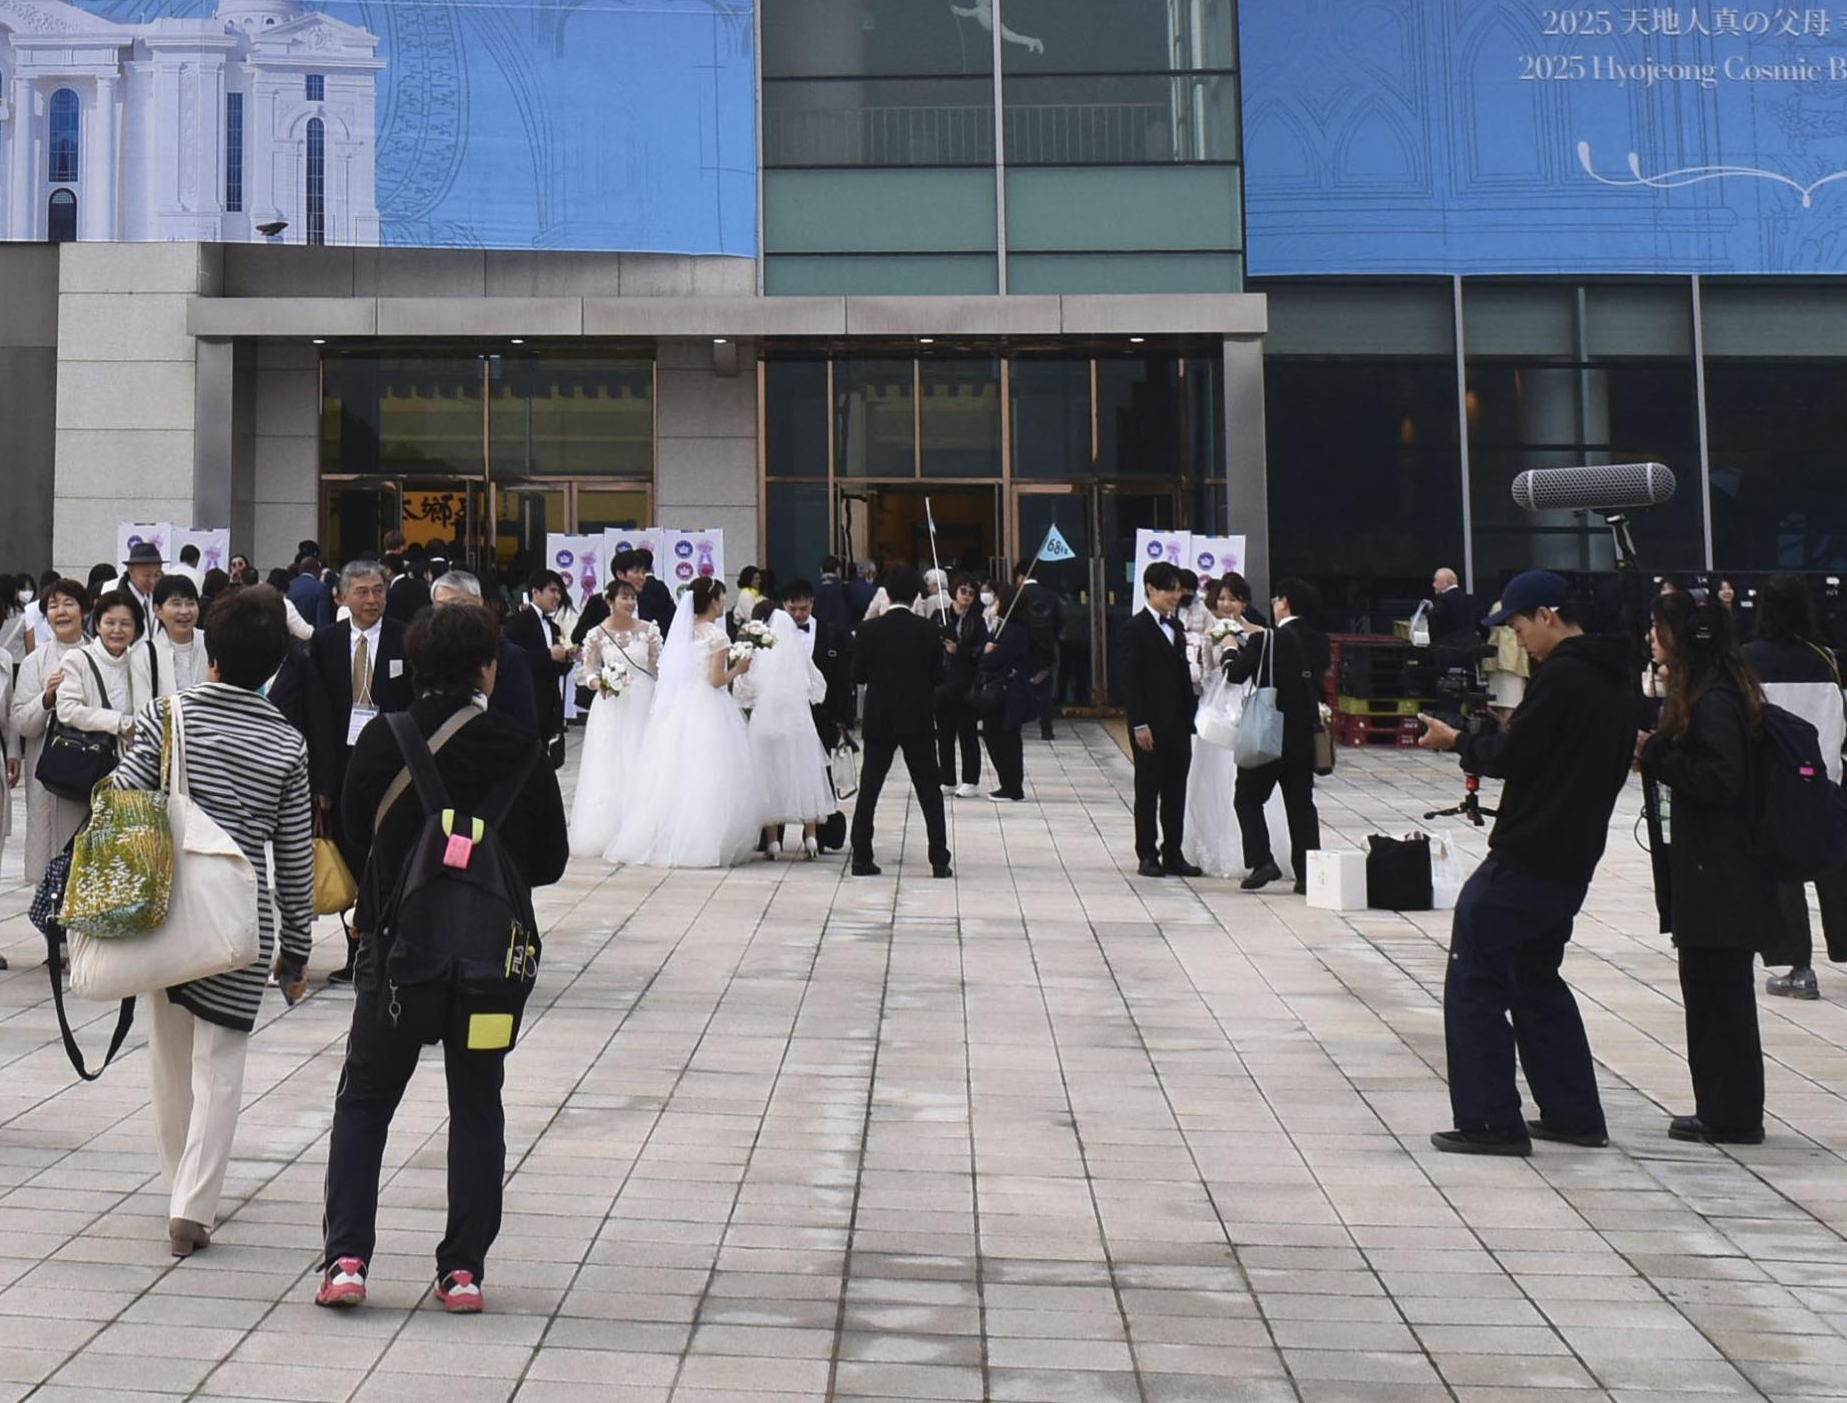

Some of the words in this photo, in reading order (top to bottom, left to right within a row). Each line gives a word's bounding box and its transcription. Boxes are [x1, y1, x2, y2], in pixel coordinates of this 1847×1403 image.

[1543, 10, 1612, 35] 2025
[1621, 8, 1830, 37] 天地人真の父母
[1518, 55, 1586, 80] 2025
[1593, 55, 1718, 89] Hyojeong
[1724, 56, 1821, 81] Cosmic
[512, 945, 524, 974] FILA
